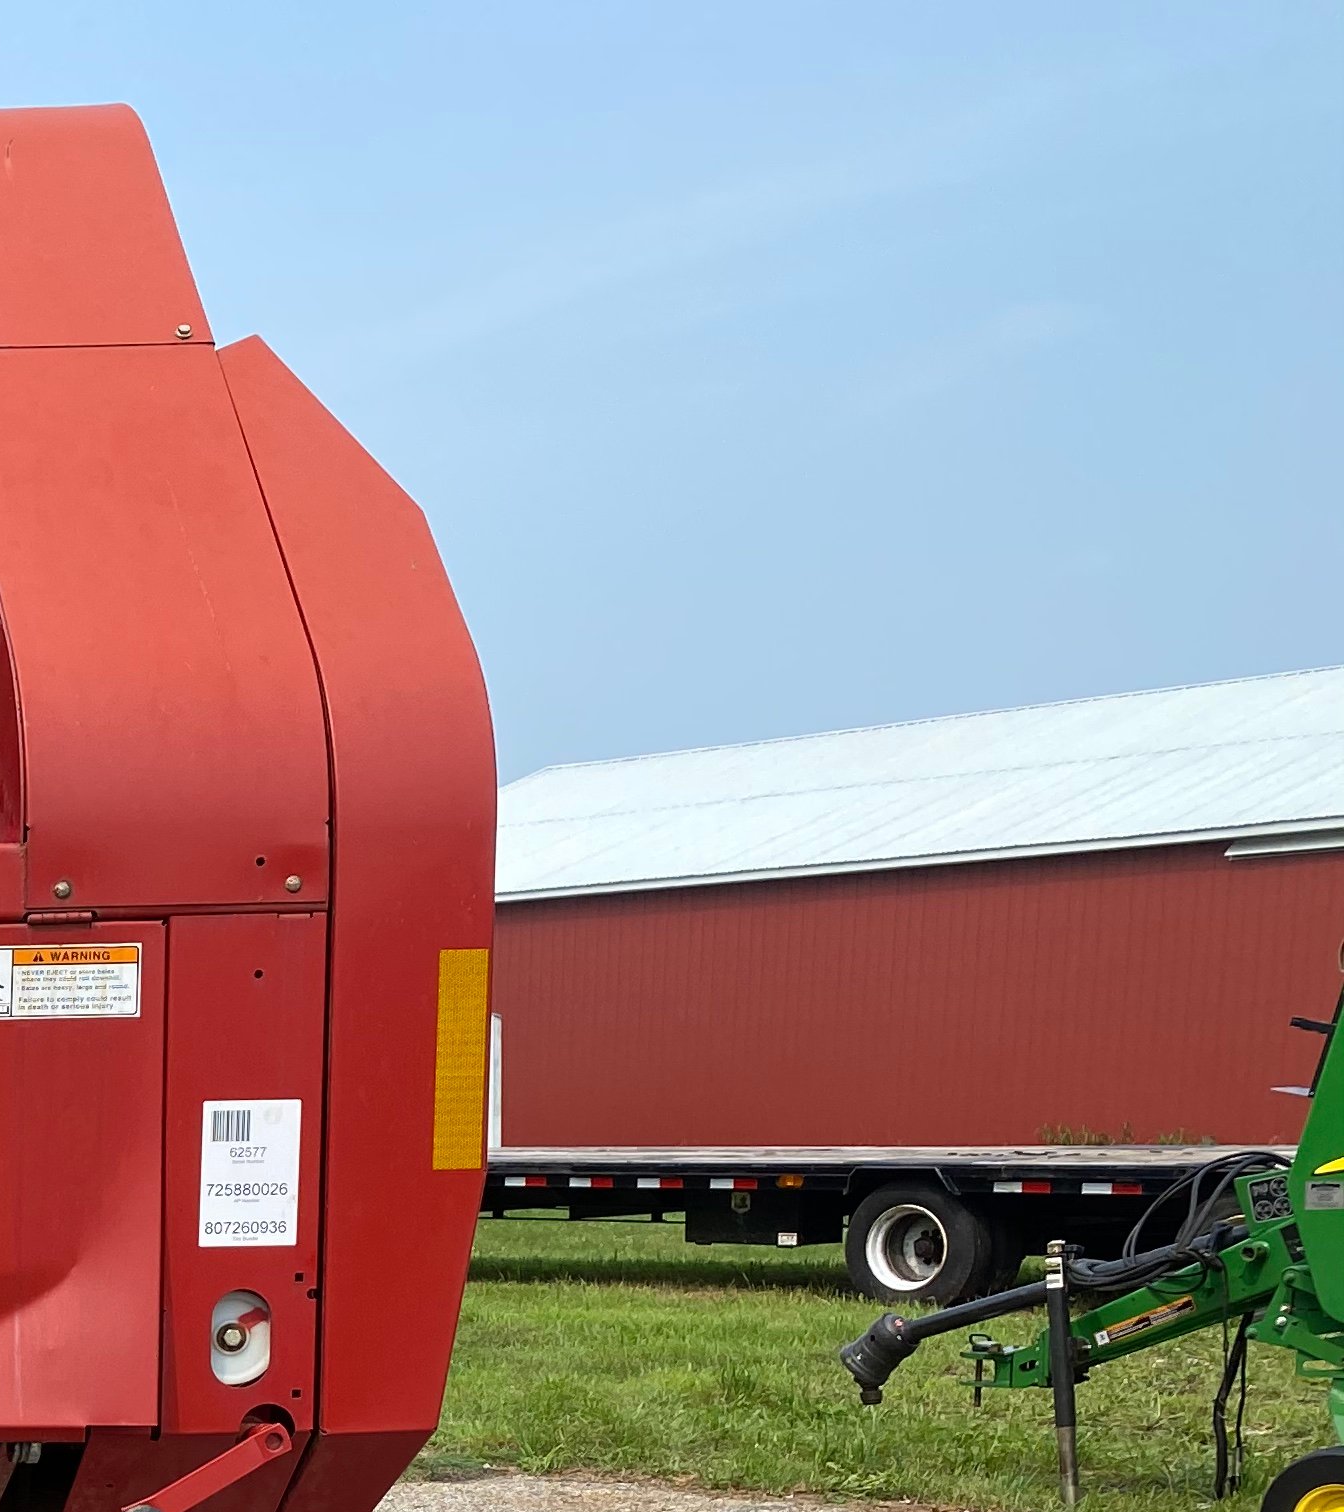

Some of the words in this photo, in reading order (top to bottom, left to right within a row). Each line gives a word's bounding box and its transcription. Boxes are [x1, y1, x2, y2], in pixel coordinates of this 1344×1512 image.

[50, 951, 111, 961] WARNING
[58, 996, 84, 1004] comply
[230, 1147, 267, 1158] 62577
[206, 1183, 288, 1197] 725880026
[204, 1221, 287, 1234] 807260936
